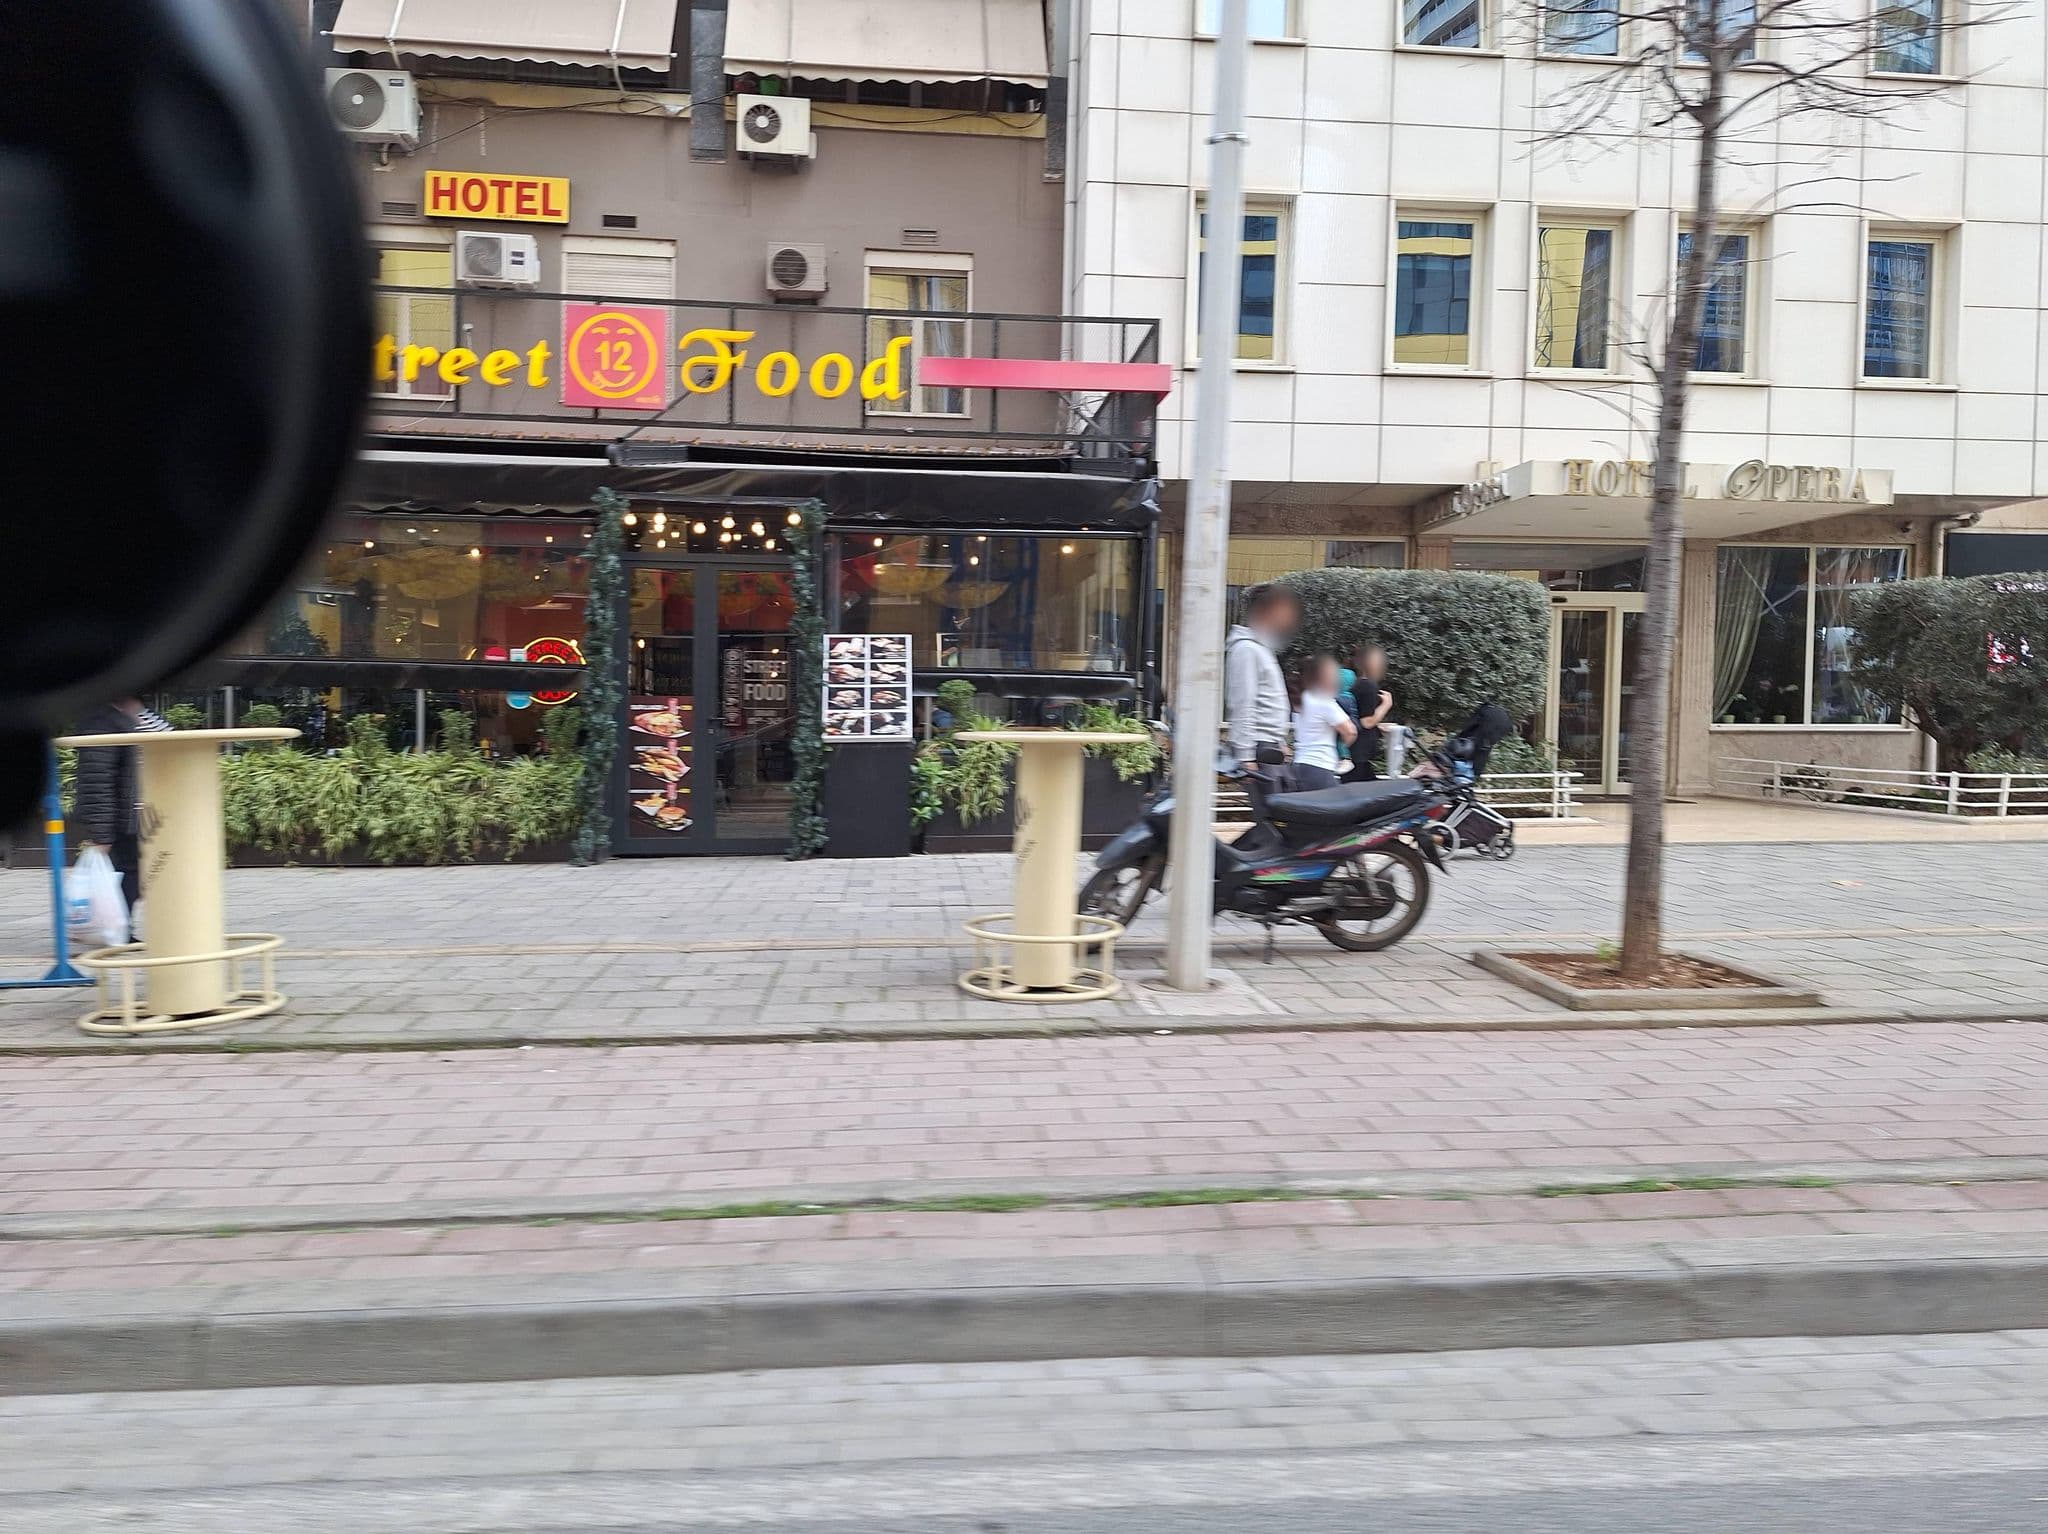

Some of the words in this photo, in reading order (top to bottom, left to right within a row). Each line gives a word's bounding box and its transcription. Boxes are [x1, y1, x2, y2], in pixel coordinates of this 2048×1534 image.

[432, 176, 562, 216] HOTEL
[373, 333, 552, 388] treet
[594, 340, 633, 371] 12
[678, 328, 912, 401] Food
[1562, 458, 1699, 499] HOTL
[1724, 459, 1869, 503] OPERA
[743, 683, 786, 700] FOOD
